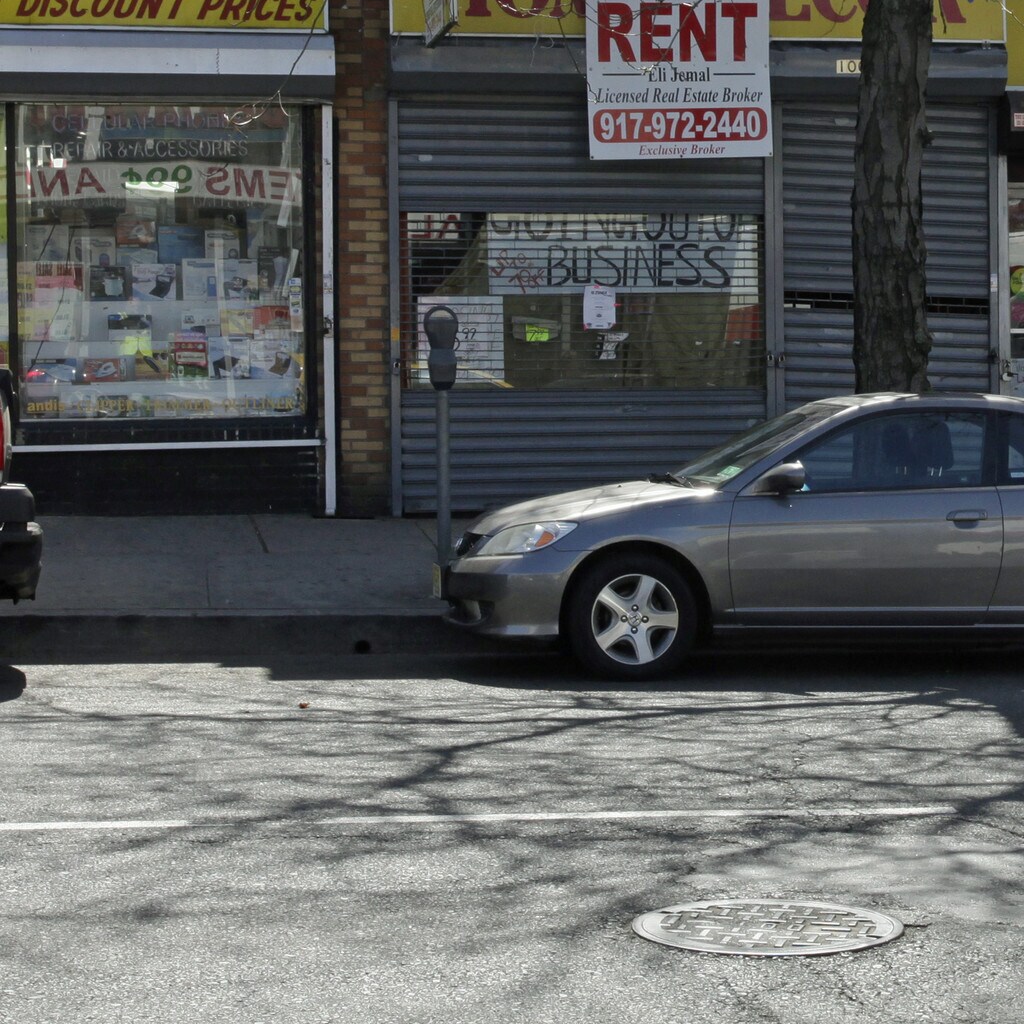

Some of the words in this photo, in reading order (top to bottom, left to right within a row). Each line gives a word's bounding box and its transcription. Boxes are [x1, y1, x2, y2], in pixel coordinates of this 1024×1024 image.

[597, 2, 758, 63] RENT
[839, 60, 861, 74] 10
[597, 87, 650, 104] Licensed
[652, 86, 680, 104] Real
[683, 86, 719, 103] Estate
[722, 86, 763, 103] Broker
[600, 110, 761, 140] 917-972-2440
[131, 140, 249, 159] ACCESSORIES
[639, 144, 688, 156] Exclusive
[691, 143, 726, 156] Broker
[547, 243, 731, 289] BUSINESS
[27, 400, 65, 413] andis
